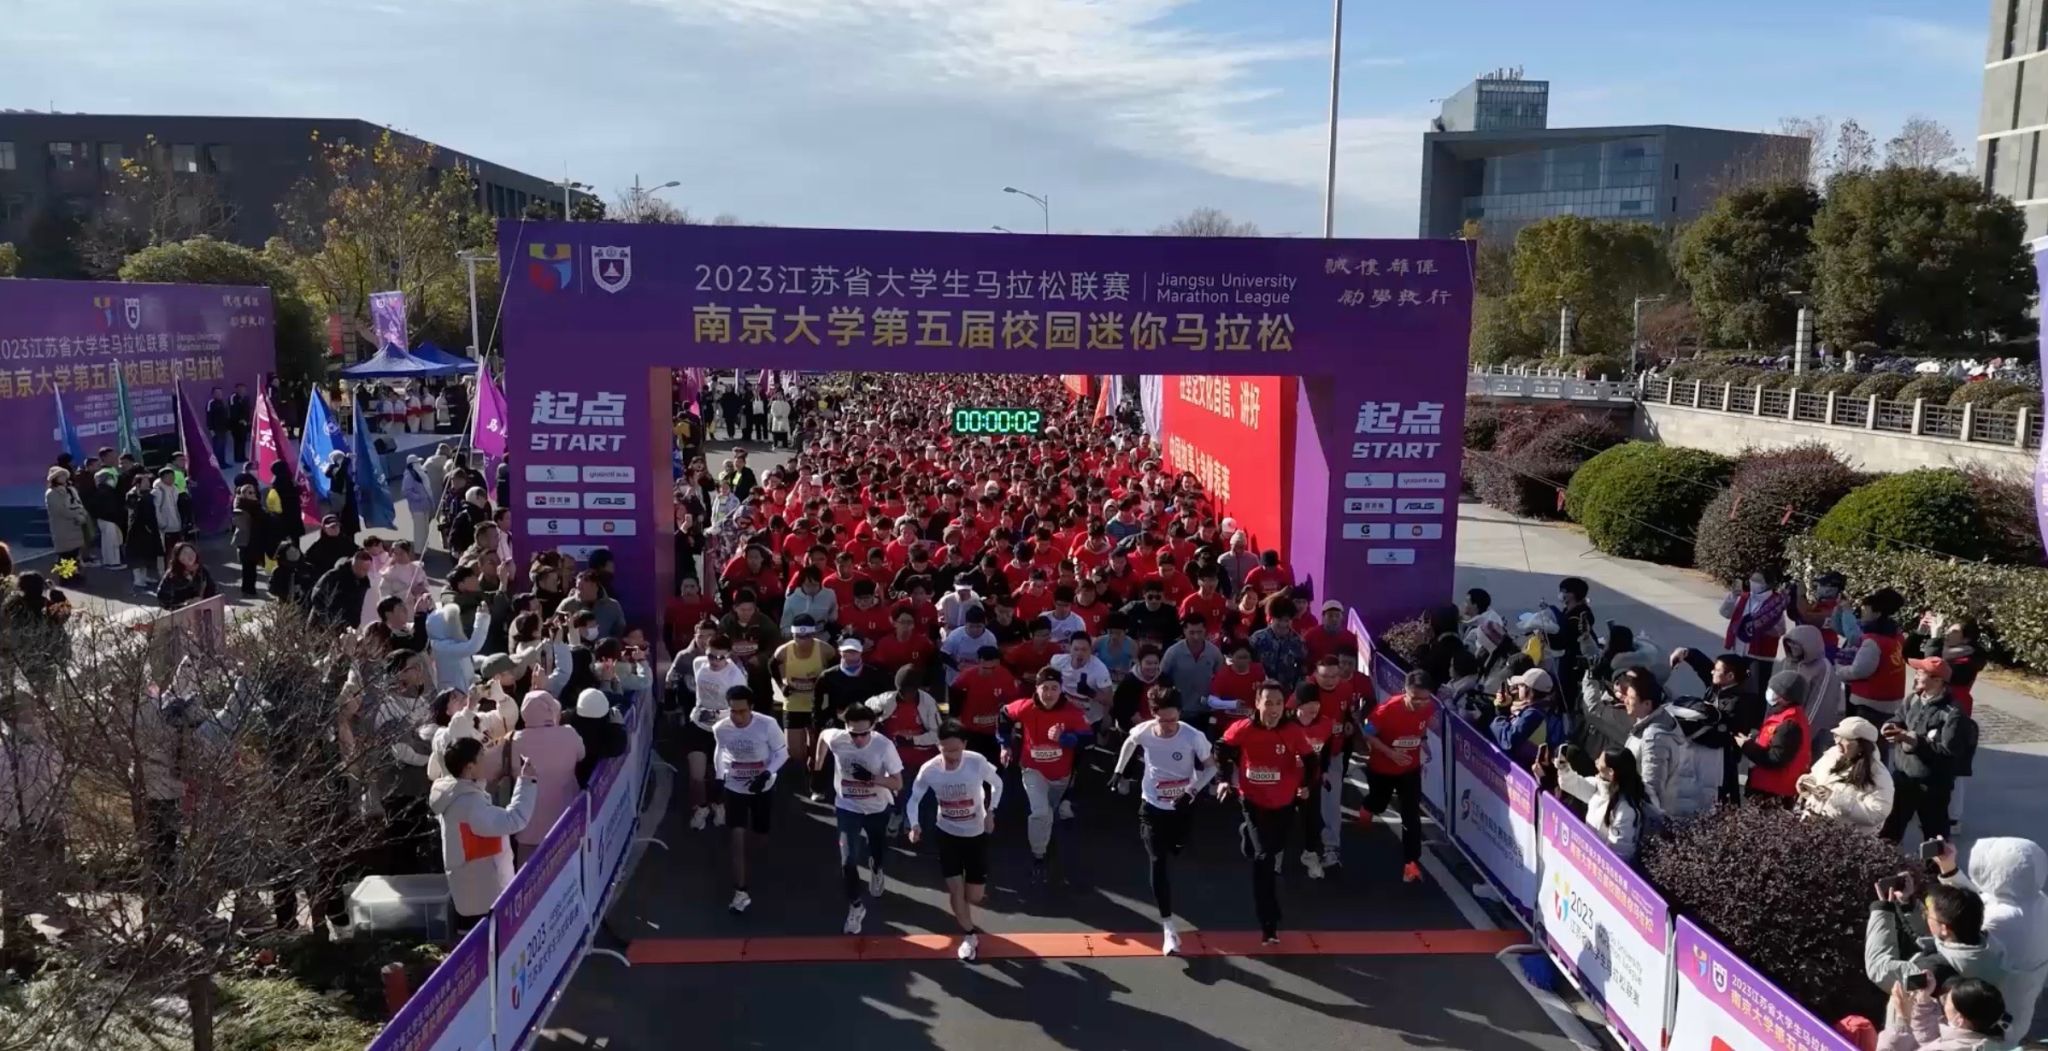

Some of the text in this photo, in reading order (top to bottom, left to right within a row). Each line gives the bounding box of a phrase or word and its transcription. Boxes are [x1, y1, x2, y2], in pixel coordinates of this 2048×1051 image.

[694, 263, 1131, 302] 2023江苏省大学生马拉松联赛
[1157, 272, 1298, 289] Jiangsu University
[1157, 288, 1291, 307] Marathon League
[693, 302, 1296, 352] 南京大学第五届校园迷你马拉松
[0, 333, 169, 360] 023江苏省大学生马拉松联赛
[531, 391, 627, 426] 起点
[956, 411, 1040, 432] 00:00:02
[1355, 402, 1444, 434] 起点
[530, 433, 627, 451] START
[1352, 442, 1442, 458] START
[1404, 502, 1435, 510] ASUS
[1571, 891, 1594, 930] 2023
[527, 922, 546, 967] 2023
